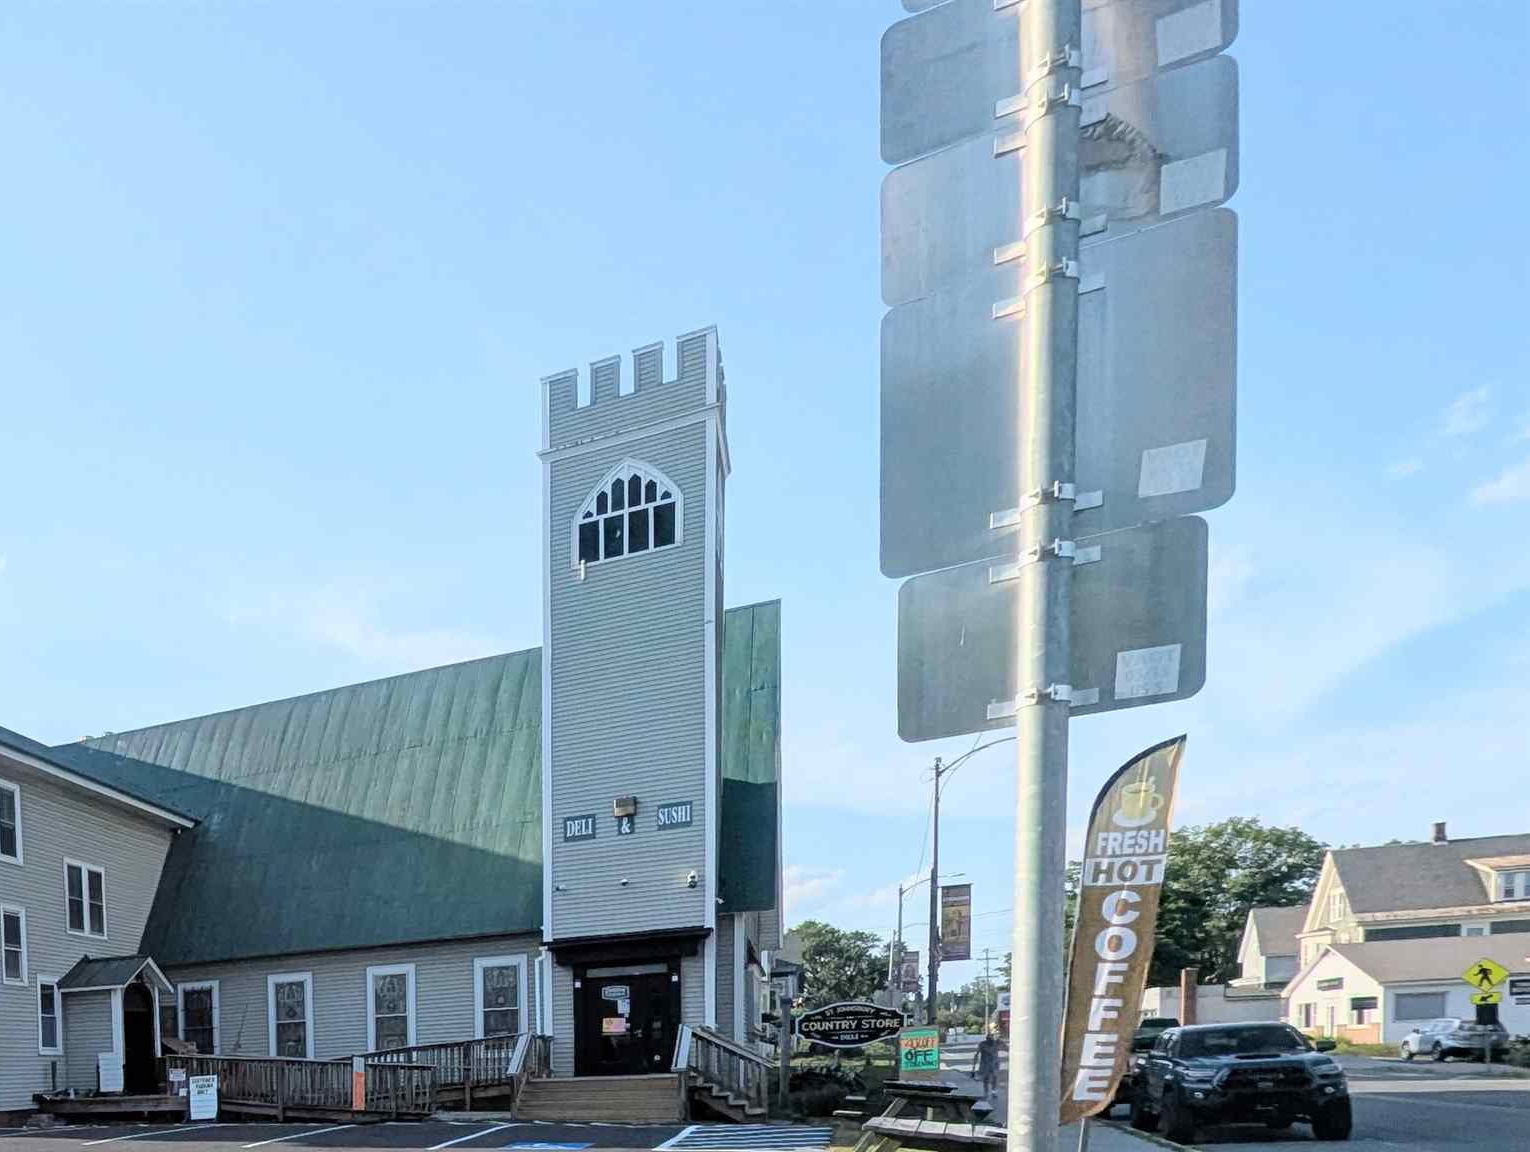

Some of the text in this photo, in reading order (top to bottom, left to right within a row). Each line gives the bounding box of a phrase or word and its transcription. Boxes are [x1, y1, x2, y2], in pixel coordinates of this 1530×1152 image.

[566, 805, 691, 837] DELI & SUSHI
[1095, 829, 1165, 856] FRESH
[1092, 860, 1163, 882] HOT
[1072, 890, 1142, 1101] COFFEE
[801, 1018, 901, 1031] COUNTRY STORE
